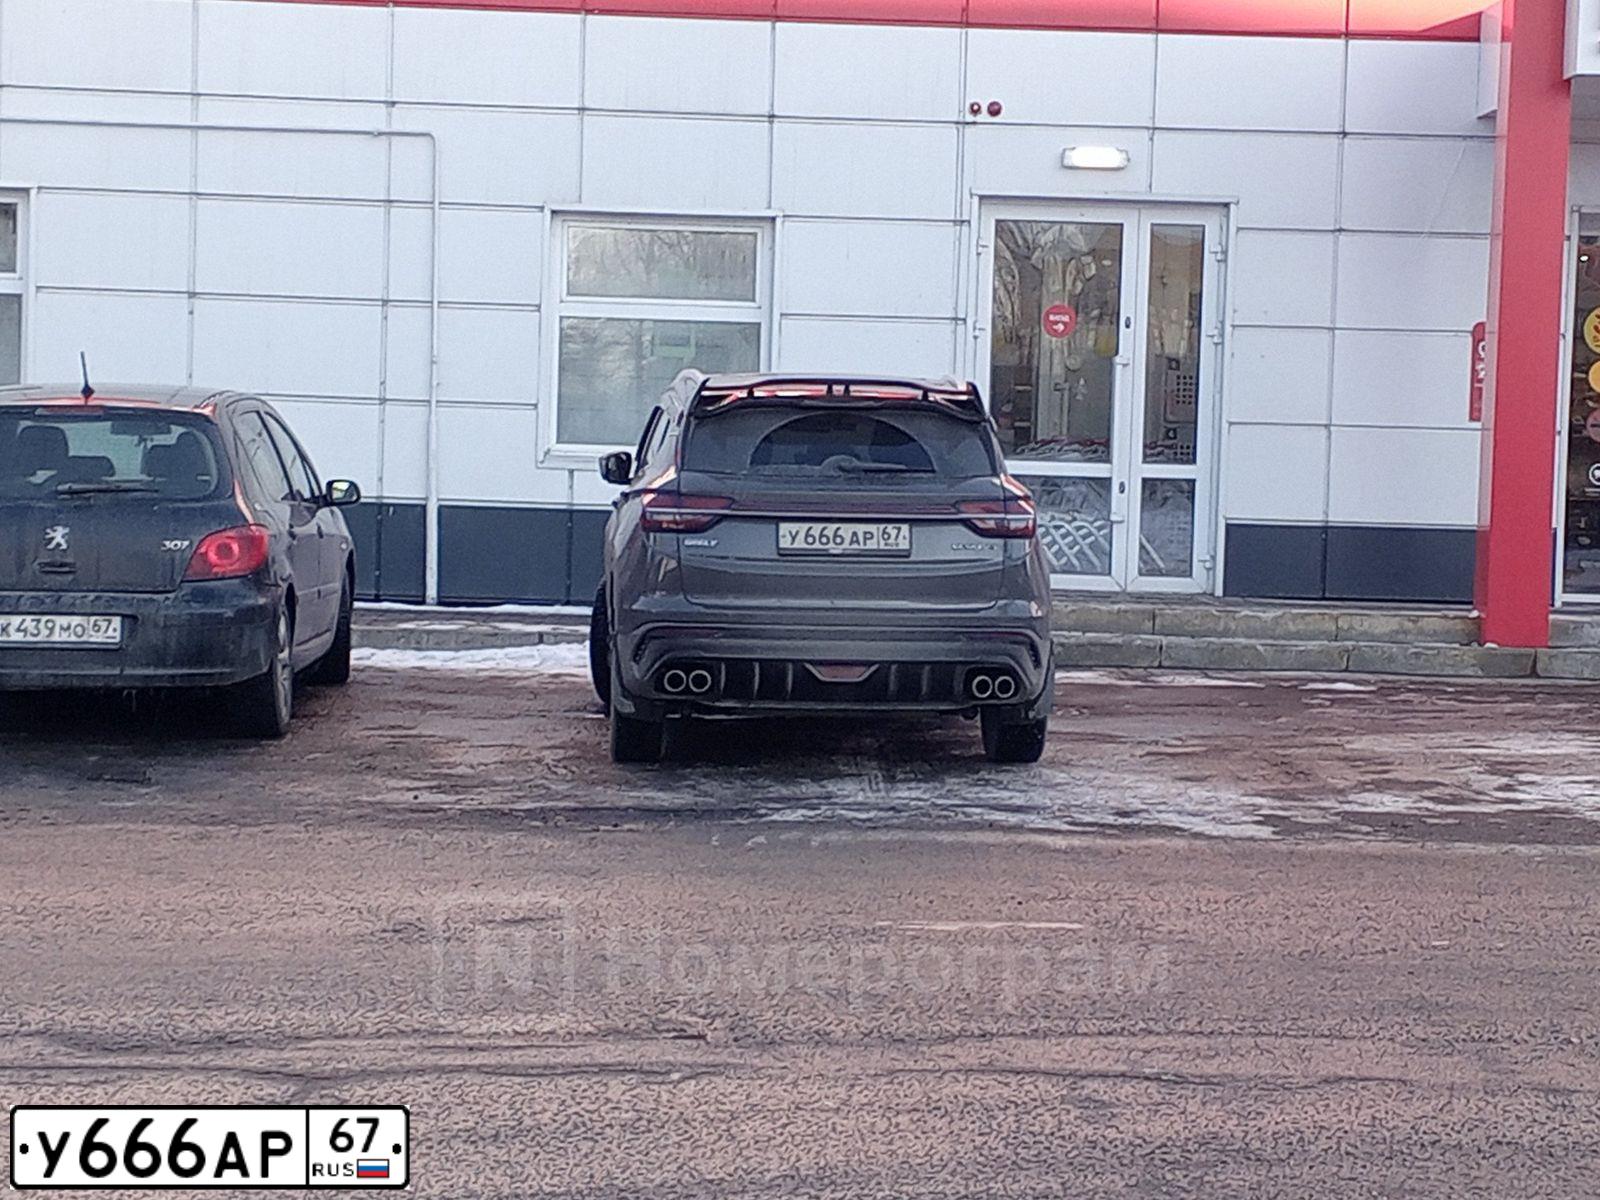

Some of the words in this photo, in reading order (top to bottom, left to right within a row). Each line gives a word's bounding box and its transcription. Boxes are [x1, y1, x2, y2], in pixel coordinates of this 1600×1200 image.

[881, 526, 901, 542] 67
[161, 540, 190, 550] 307
[92, 618, 112, 633] 67
